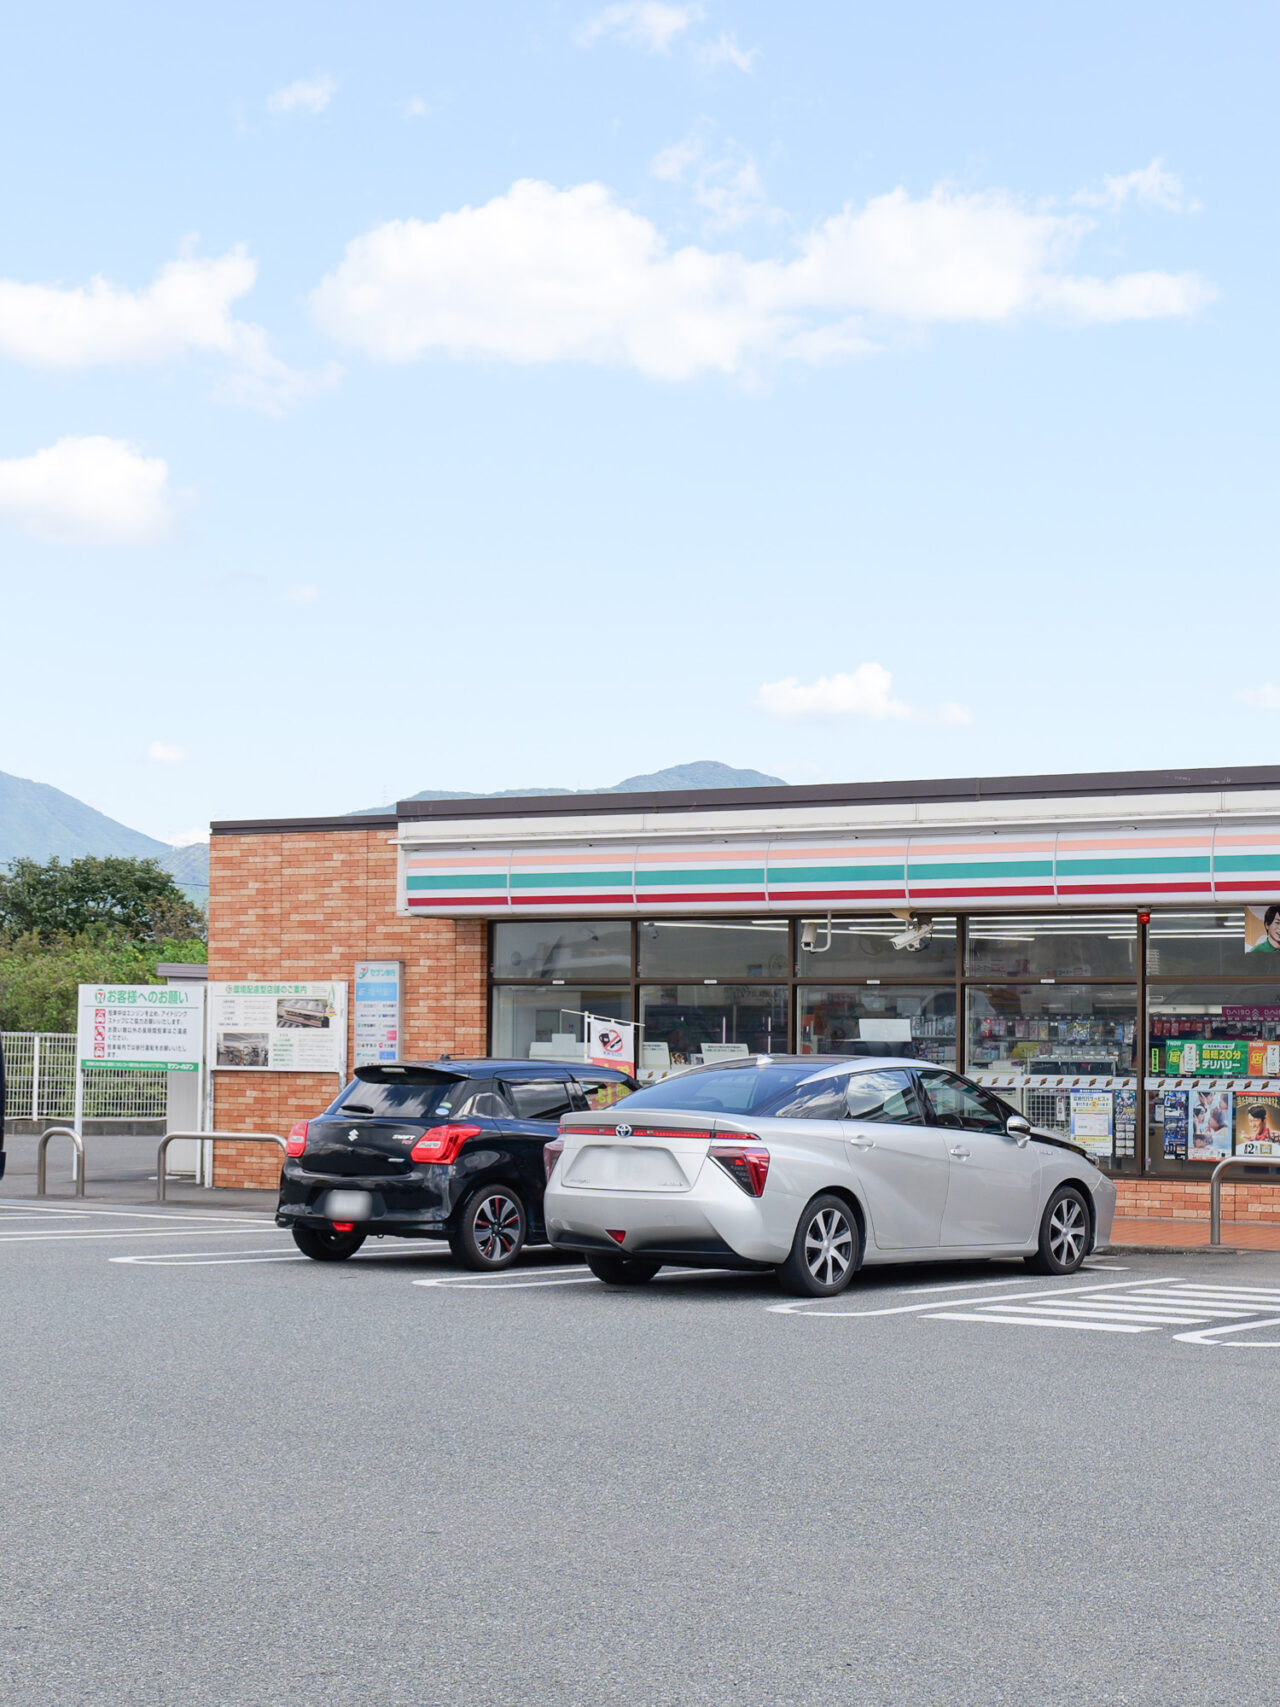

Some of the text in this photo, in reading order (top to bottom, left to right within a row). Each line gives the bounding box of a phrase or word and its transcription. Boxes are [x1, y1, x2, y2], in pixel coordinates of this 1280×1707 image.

[107, 990, 189, 1004] お客様へのお願い
[1202, 1050, 1241, 1060] 最短20分
[1202, 1060, 1240, 1069] デリバリー
